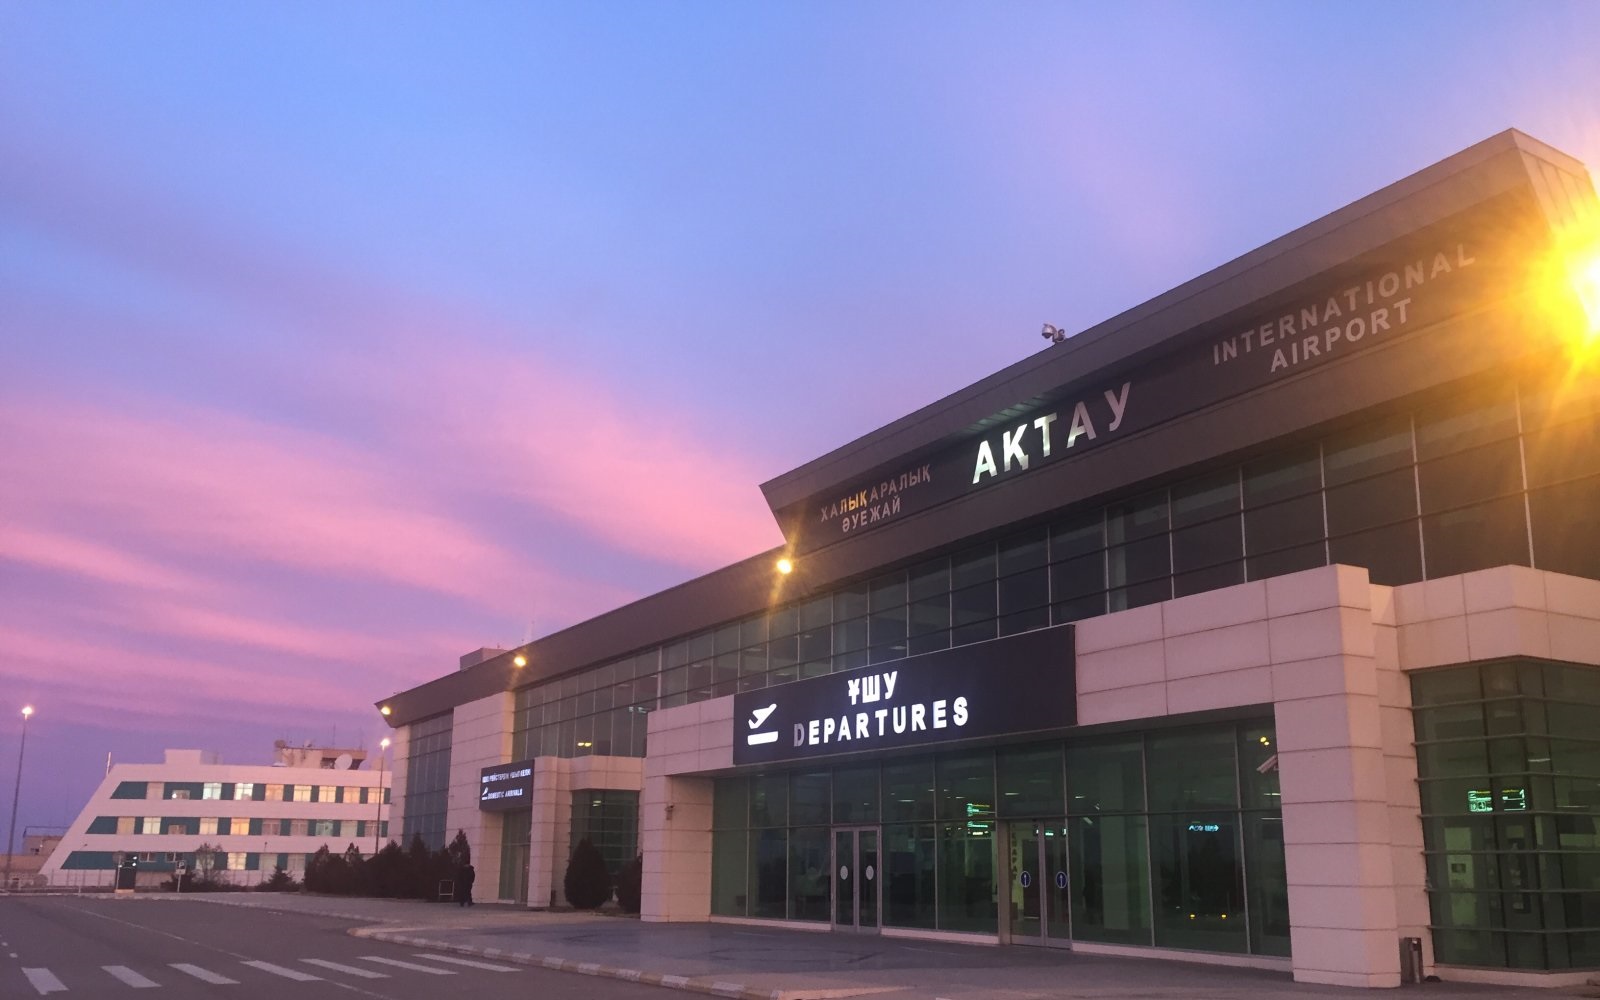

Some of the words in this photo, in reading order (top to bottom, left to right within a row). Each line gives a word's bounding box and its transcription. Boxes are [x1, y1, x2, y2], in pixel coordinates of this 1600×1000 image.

[1213, 243, 1476, 366] INTERNATIONAL
[1270, 298, 1412, 373] AIRPORT
[972, 381, 1131, 484] АҚТАУ
[821, 463, 931, 522] ХАЛЫҚАРАЛЫҚ
[842, 496, 901, 532] ӘУЕЖАЙ
[848, 670, 898, 706] ҰШУ
[793, 696, 969, 747] DEPARTURES
